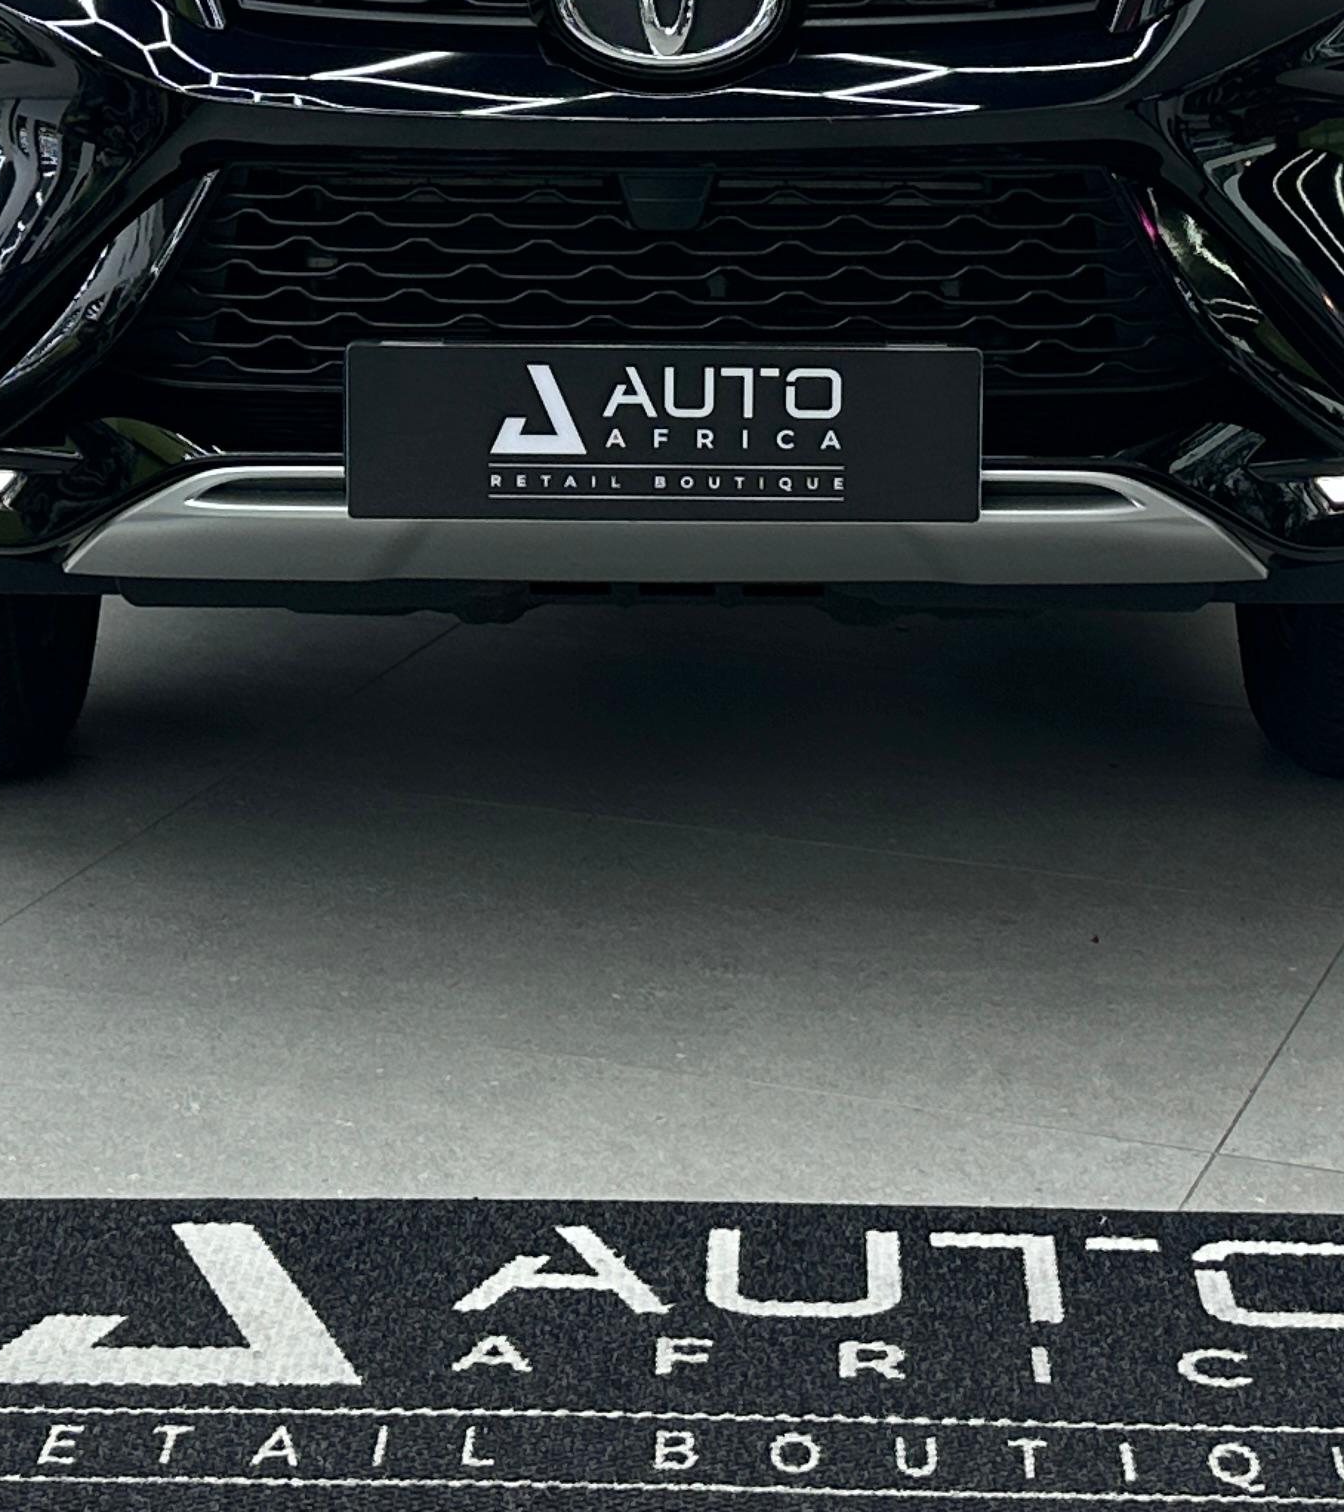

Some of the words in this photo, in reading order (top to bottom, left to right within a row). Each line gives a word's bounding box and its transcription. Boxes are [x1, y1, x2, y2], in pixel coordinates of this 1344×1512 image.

[602, 366, 843, 419] AUTO
[605, 428, 842, 450] AFRICA
[490, 474, 622, 489] RETAIL
[654, 475, 845, 492] BOUTIQUE
